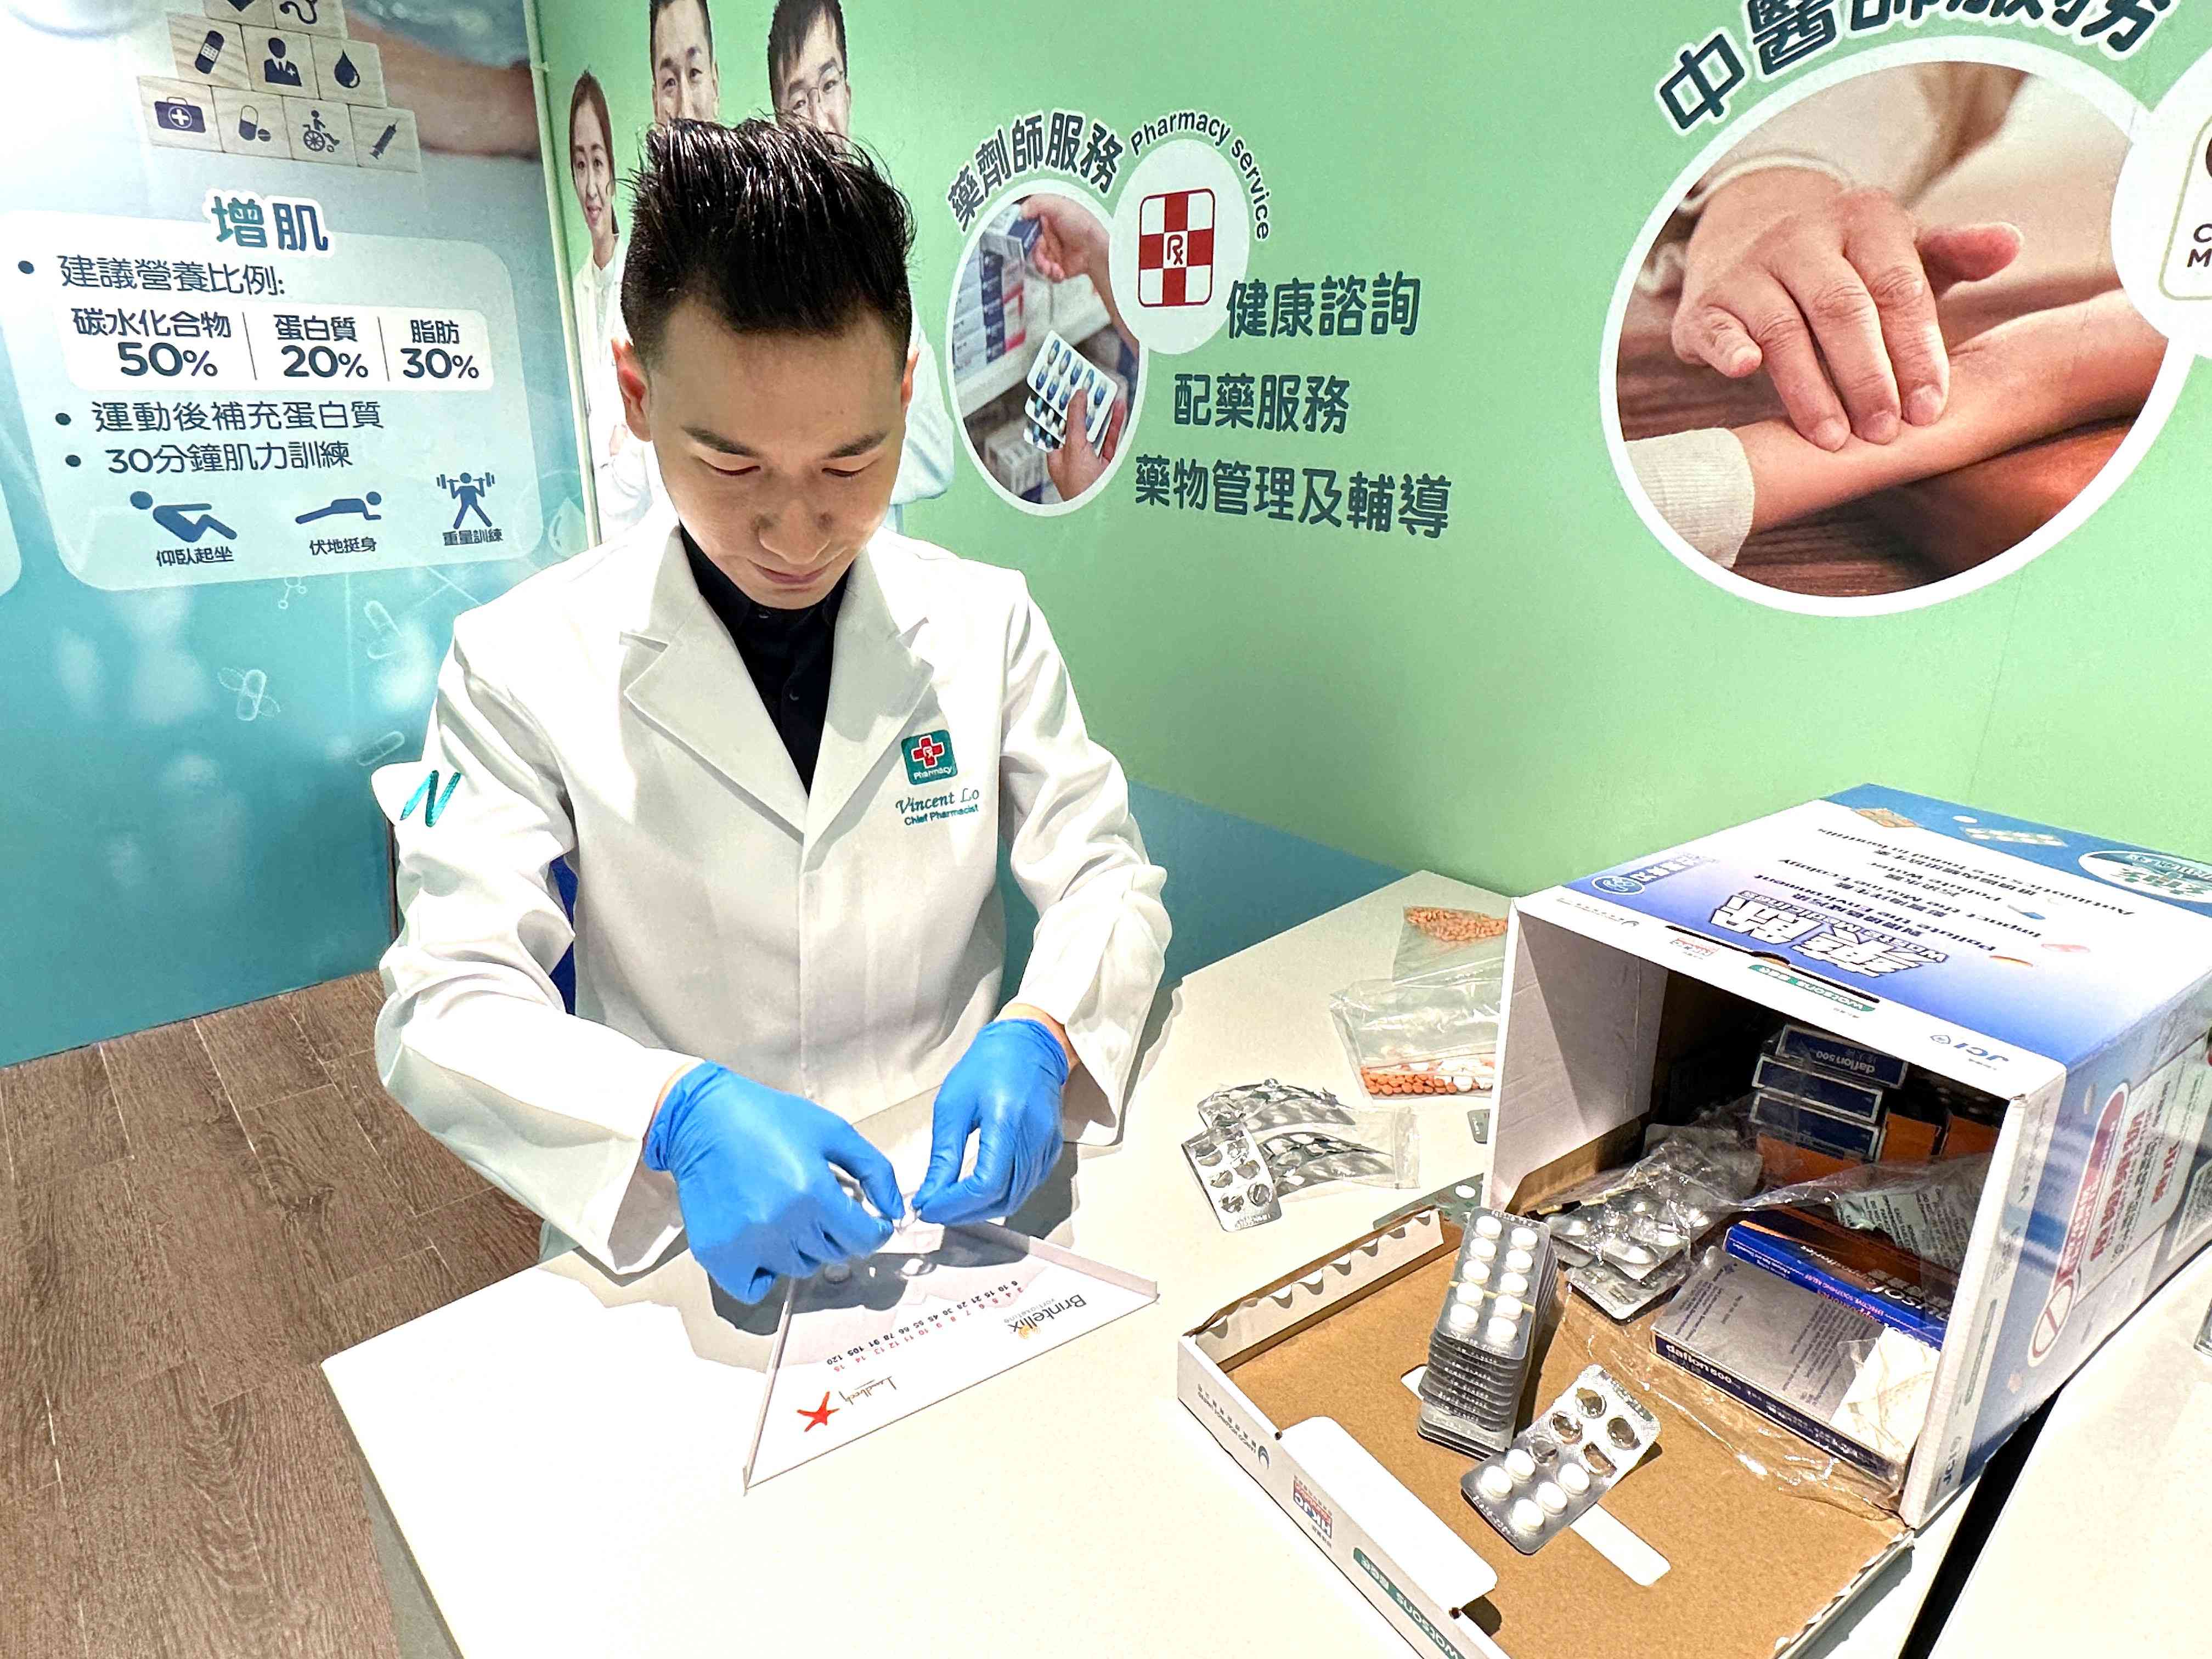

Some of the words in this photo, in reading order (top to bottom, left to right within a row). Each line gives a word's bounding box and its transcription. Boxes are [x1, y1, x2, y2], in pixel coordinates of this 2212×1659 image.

[948, 112, 1124, 232] 藥劑師服務
[1131, 111, 1231, 156] Pharmacy
[1232, 139, 1270, 240] service
[212, 195, 330, 252] 增肌
[59, 254, 285, 297] 建議營養比例:
[1226, 270, 1421, 339] 健康諮詢
[72, 308, 233, 339] 碳水化合物
[275, 315, 358, 343] 蛋白質
[410, 319, 461, 345] 脂肪
[119, 342, 218, 378] 50%
[283, 346, 369, 379] 20%
[402, 347, 479, 380] 30%
[92, 401, 385, 433] 運動後補充蛋白質
[1173, 371, 1351, 435] 配藥服務
[106, 441, 353, 473] 30分鐘肌力訓練
[1135, 453, 1452, 539] 藥物管理及輔導
[156, 545, 234, 567] 仰臥起坐
[308, 538, 377, 556] 伏地挺身
[913, 766, 952, 780] Pharmacy
[895, 792, 955, 815] Vincent
[960, 788, 979, 803] Lo
[904, 814, 928, 826] Chief
[929, 804, 979, 821] Pharmacist
[1736, 889, 1865, 933] Medicines
[1815, 1050, 1836, 1063] 500
[1836, 1055, 1876, 1074] daflon
[1953, 1043, 2010, 1062] JCI
[1007, 1294, 1087, 1333] Brintellix
[1666, 1344, 1709, 1372] daflon
